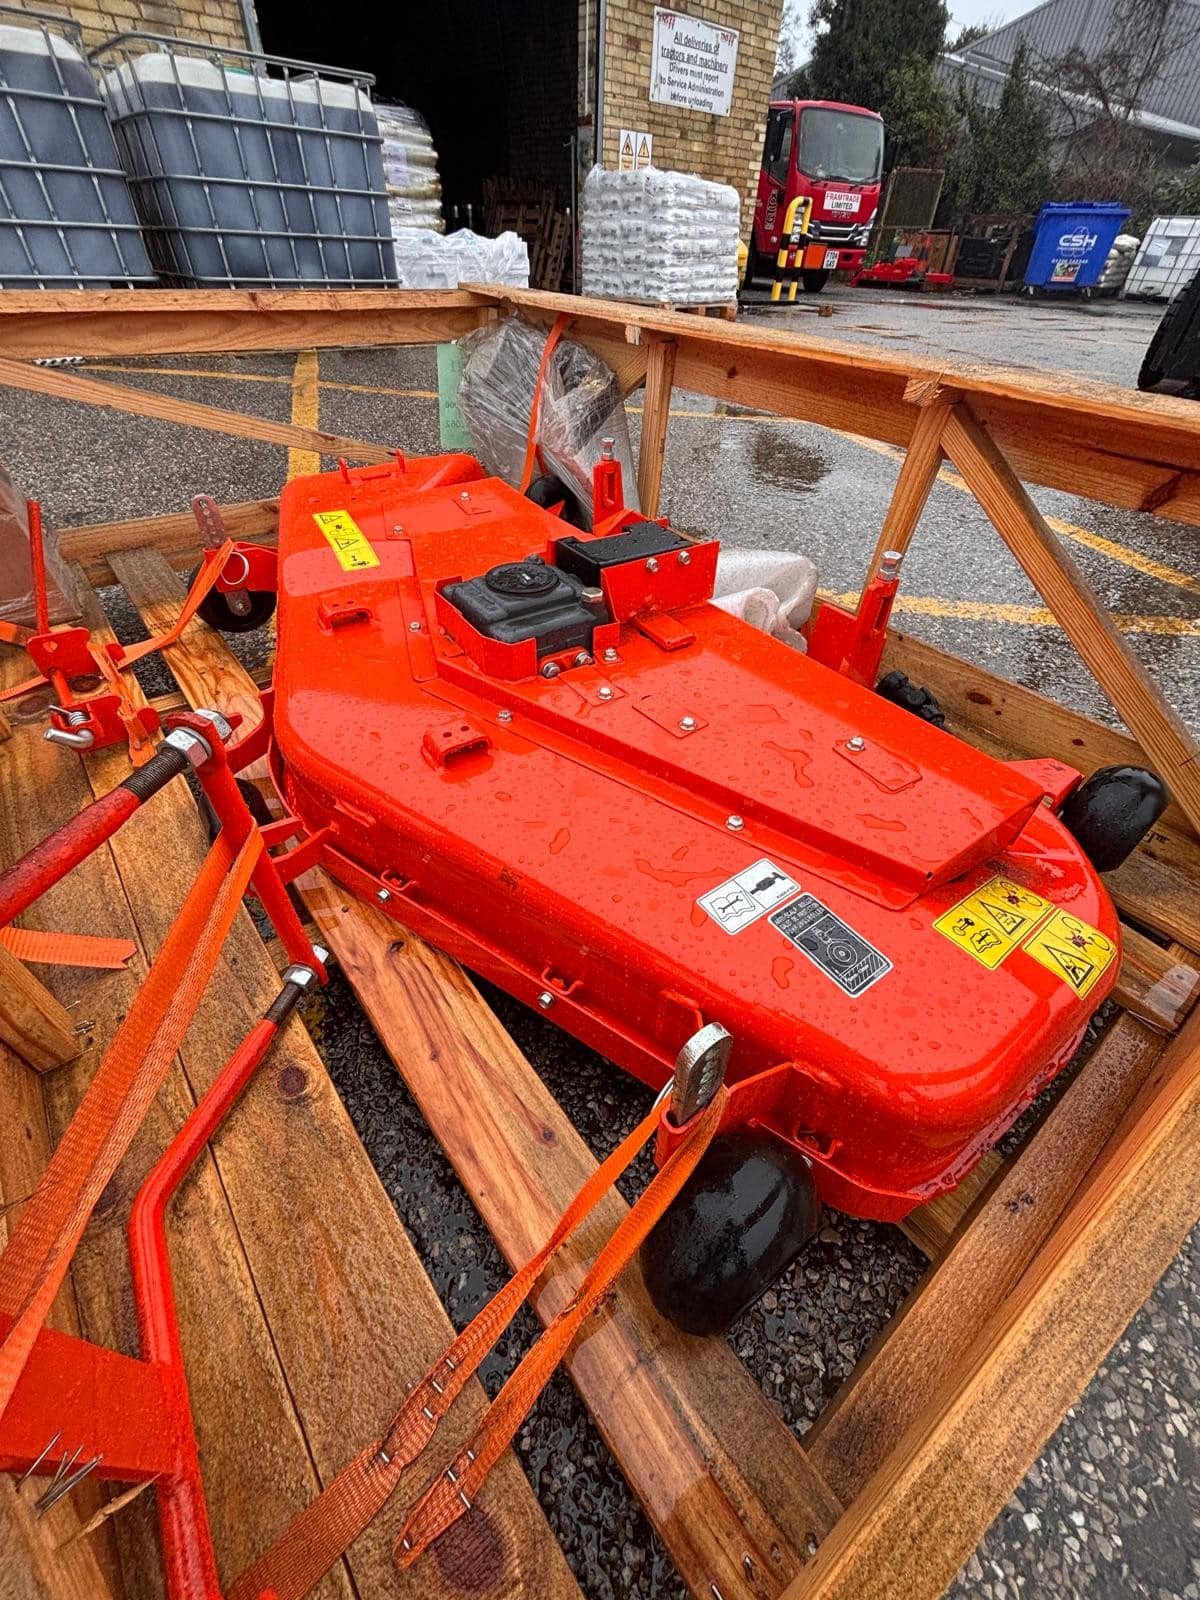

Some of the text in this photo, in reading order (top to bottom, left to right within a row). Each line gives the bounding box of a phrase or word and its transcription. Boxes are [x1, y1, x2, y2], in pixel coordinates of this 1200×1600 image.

[673, 31, 683, 44] All
[684, 34, 713, 54] deliveries
[713, 44, 720, 55] of
[661, 45, 728, 73] tractors and machinery
[669, 62, 719, 85] Drivers must report
[659, 74, 725, 98] to Service Administration
[670, 91, 687, 104] before
[831, 201, 854, 210] LIMITED
[1058, 234, 1098, 247] CSH
